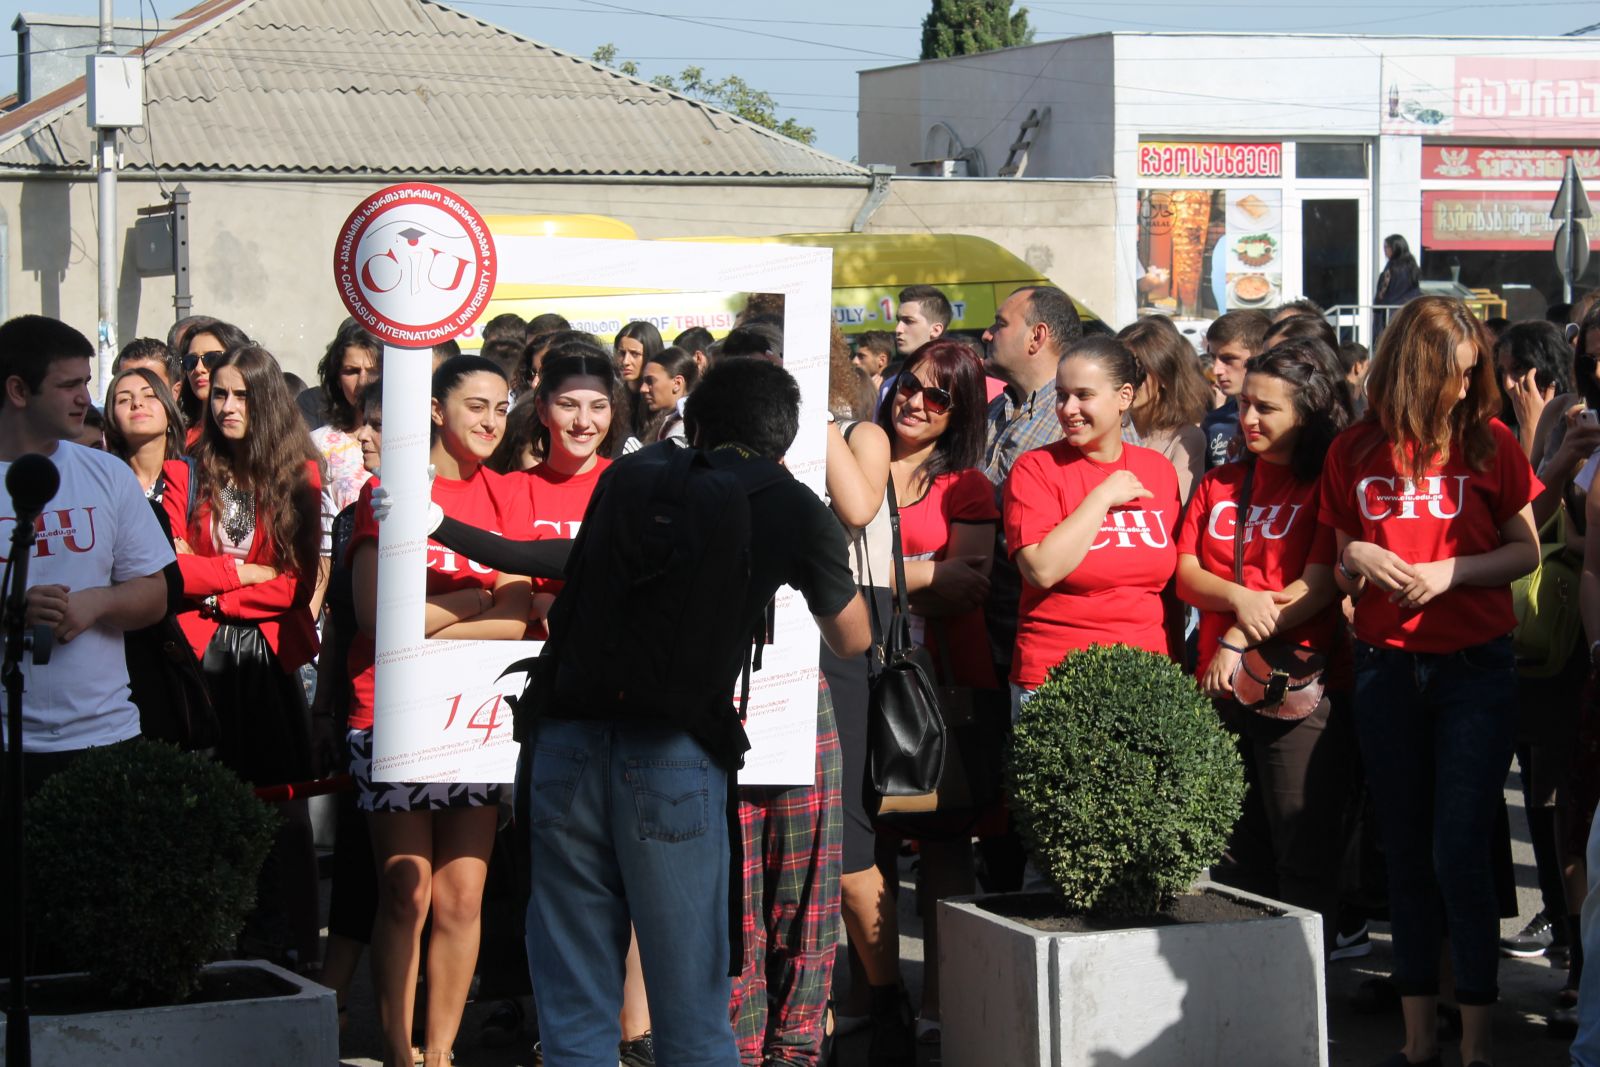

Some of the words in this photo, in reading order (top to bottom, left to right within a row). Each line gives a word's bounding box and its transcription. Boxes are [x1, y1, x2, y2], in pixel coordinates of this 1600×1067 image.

[1140, 146, 1281, 174] ჩამოსასხმელი
[341, 273, 377, 326] CAUCASUS
[376, 322, 458, 341] INTERNATIONAL
[457, 270, 491, 325] UNIVERSITY
[834, 307, 864, 323] ULY
[881, 298, 892, 321] 1
[673, 314, 732, 329] TBILISI
[1356, 475, 1470, 520] CIU
[478, 738, 513, 750] Univers
